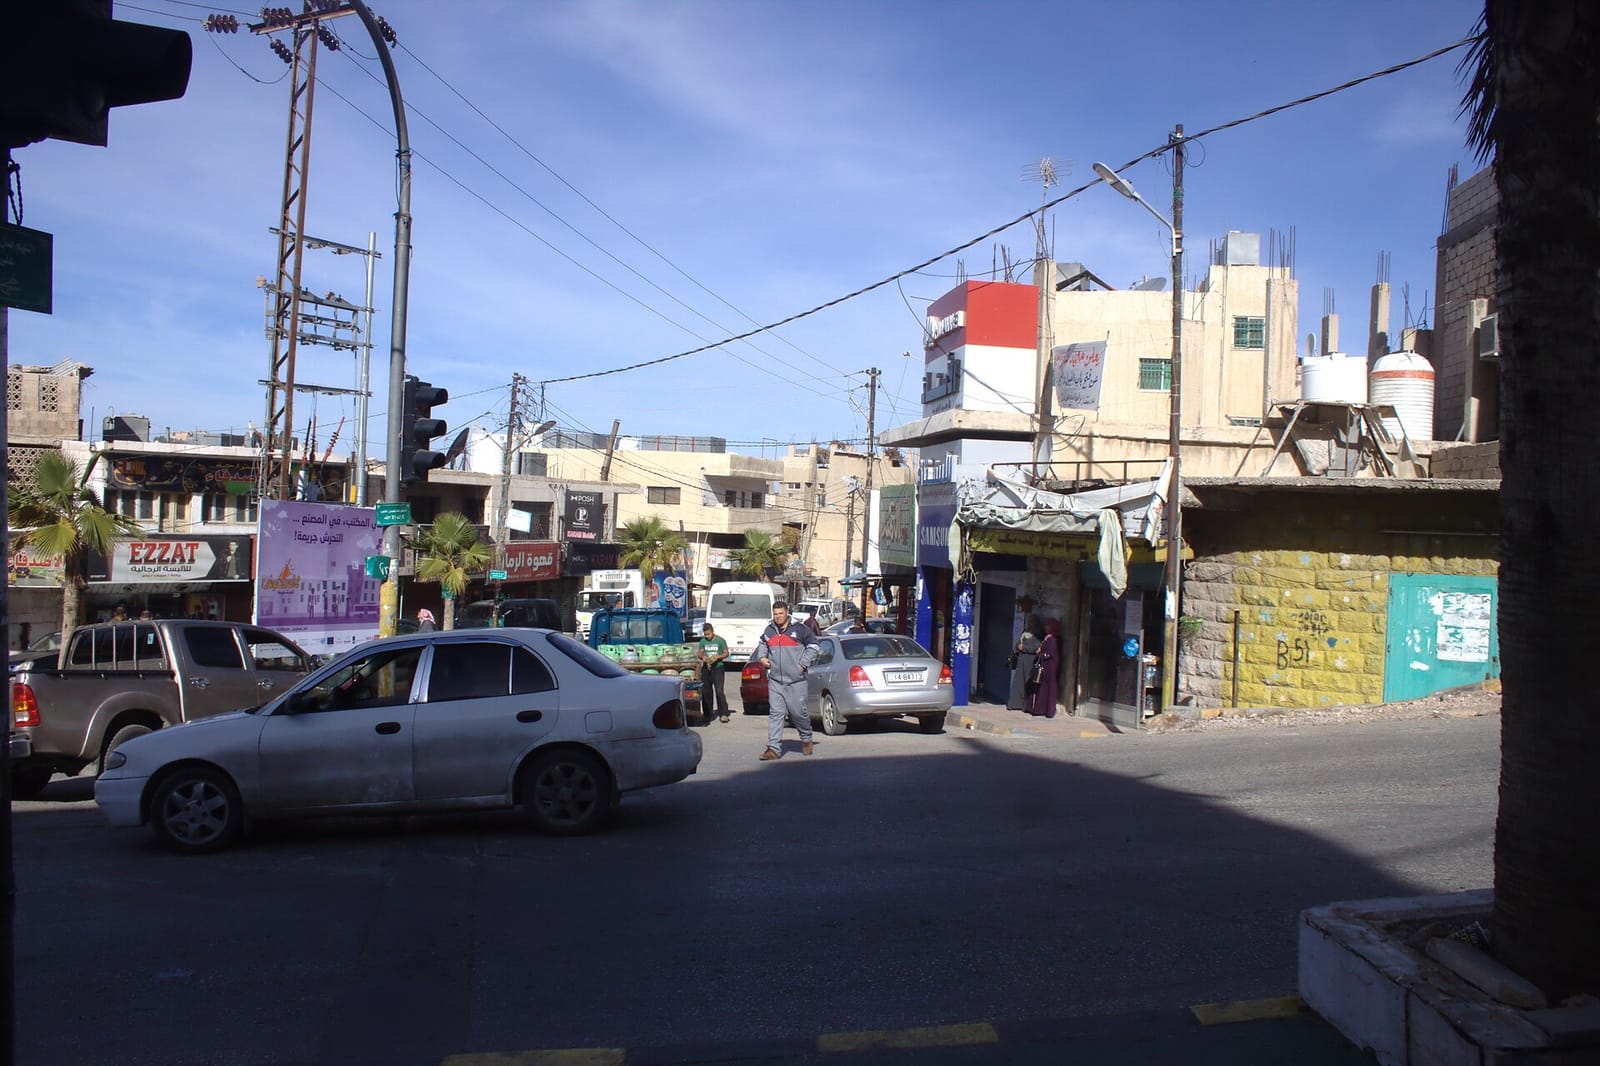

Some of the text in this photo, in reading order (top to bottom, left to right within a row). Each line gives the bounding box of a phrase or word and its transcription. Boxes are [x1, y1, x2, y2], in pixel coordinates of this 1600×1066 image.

[301, 514, 328, 526] المصنع
[329, 516, 342, 528] في
[294, 531, 344, 545] التحرش جريمة!
[920, 526, 948, 547] SAMSU
[128, 542, 200, 566] EZZAT
[502, 551, 525, 573] الرما
[527, 552, 553, 572] قهوة
